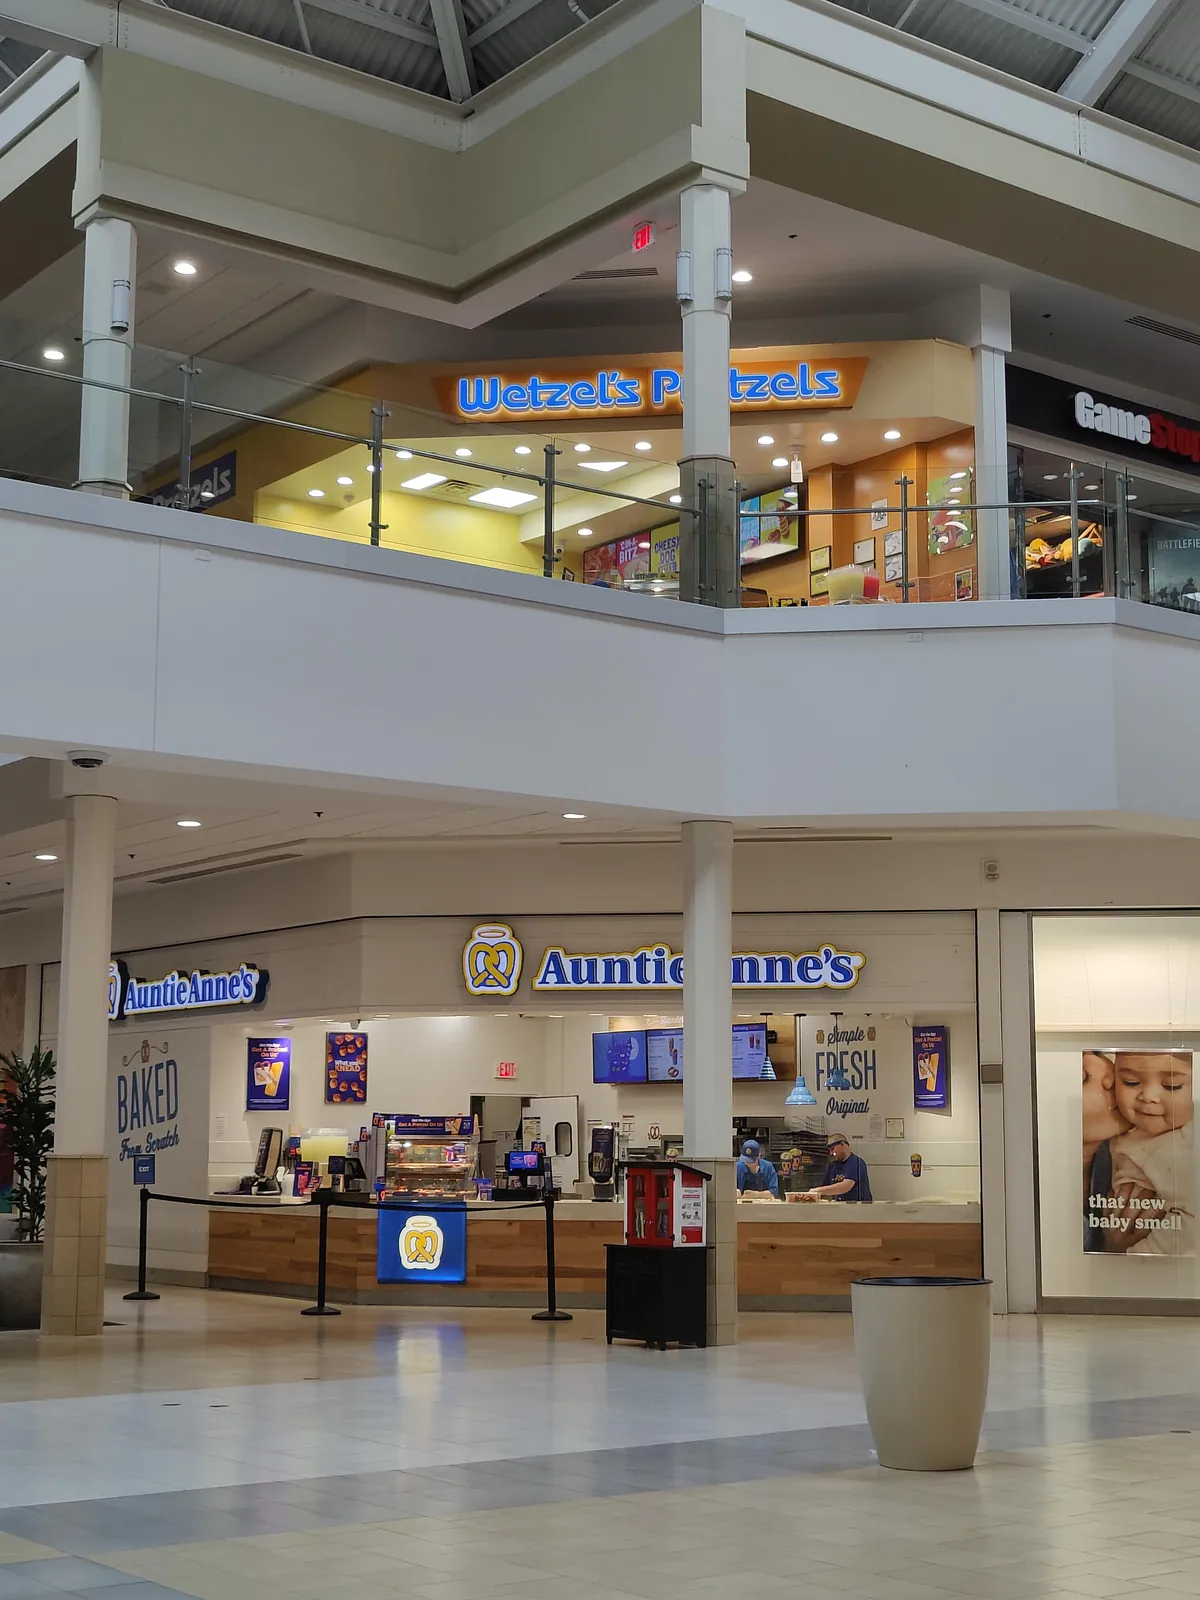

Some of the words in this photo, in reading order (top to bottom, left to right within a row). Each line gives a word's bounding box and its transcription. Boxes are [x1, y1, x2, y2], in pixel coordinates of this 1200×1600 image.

[458, 371, 641, 413] Wetzel's
[652, 364, 840, 406] Ptzels
[538, 947, 683, 985] Auntie
[732, 948, 853, 983] nne's
[827, 1026, 865, 1047] Simple
[816, 1050, 876, 1091] FRESH
[117, 1059, 178, 1134] BAKED
[826, 1097, 870, 1119] Original
[146, 1124, 180, 1153] Scratch
[1089, 1193, 1125, 1209] that
[1129, 1198, 1165, 1210] new
[1089, 1213, 1130, 1232] baby
[1135, 1215, 1182, 1230] smell
